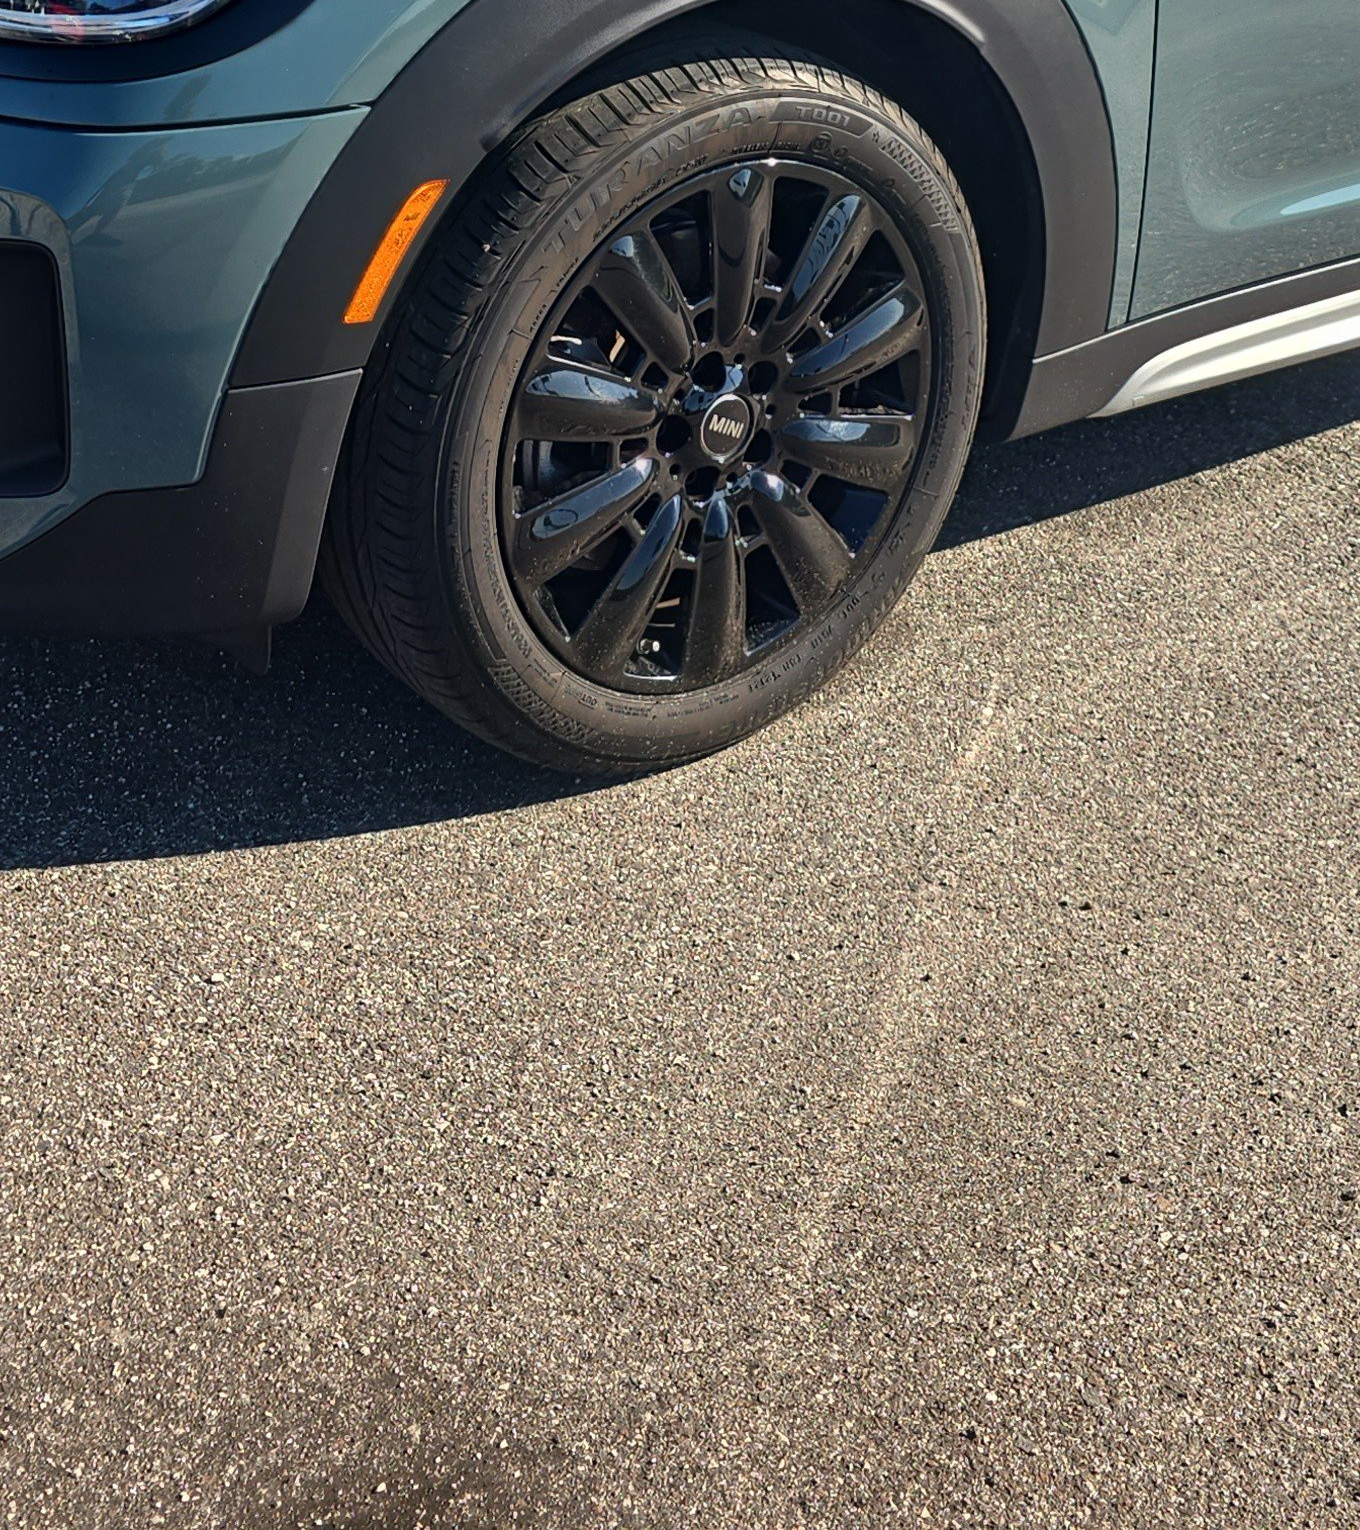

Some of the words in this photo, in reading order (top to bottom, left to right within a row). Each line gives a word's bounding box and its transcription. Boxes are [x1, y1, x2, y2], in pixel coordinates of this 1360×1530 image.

[542, 106, 753, 255] TURANZA
[795, 104, 850, 128] T001
[708, 413, 745, 439] MINI
